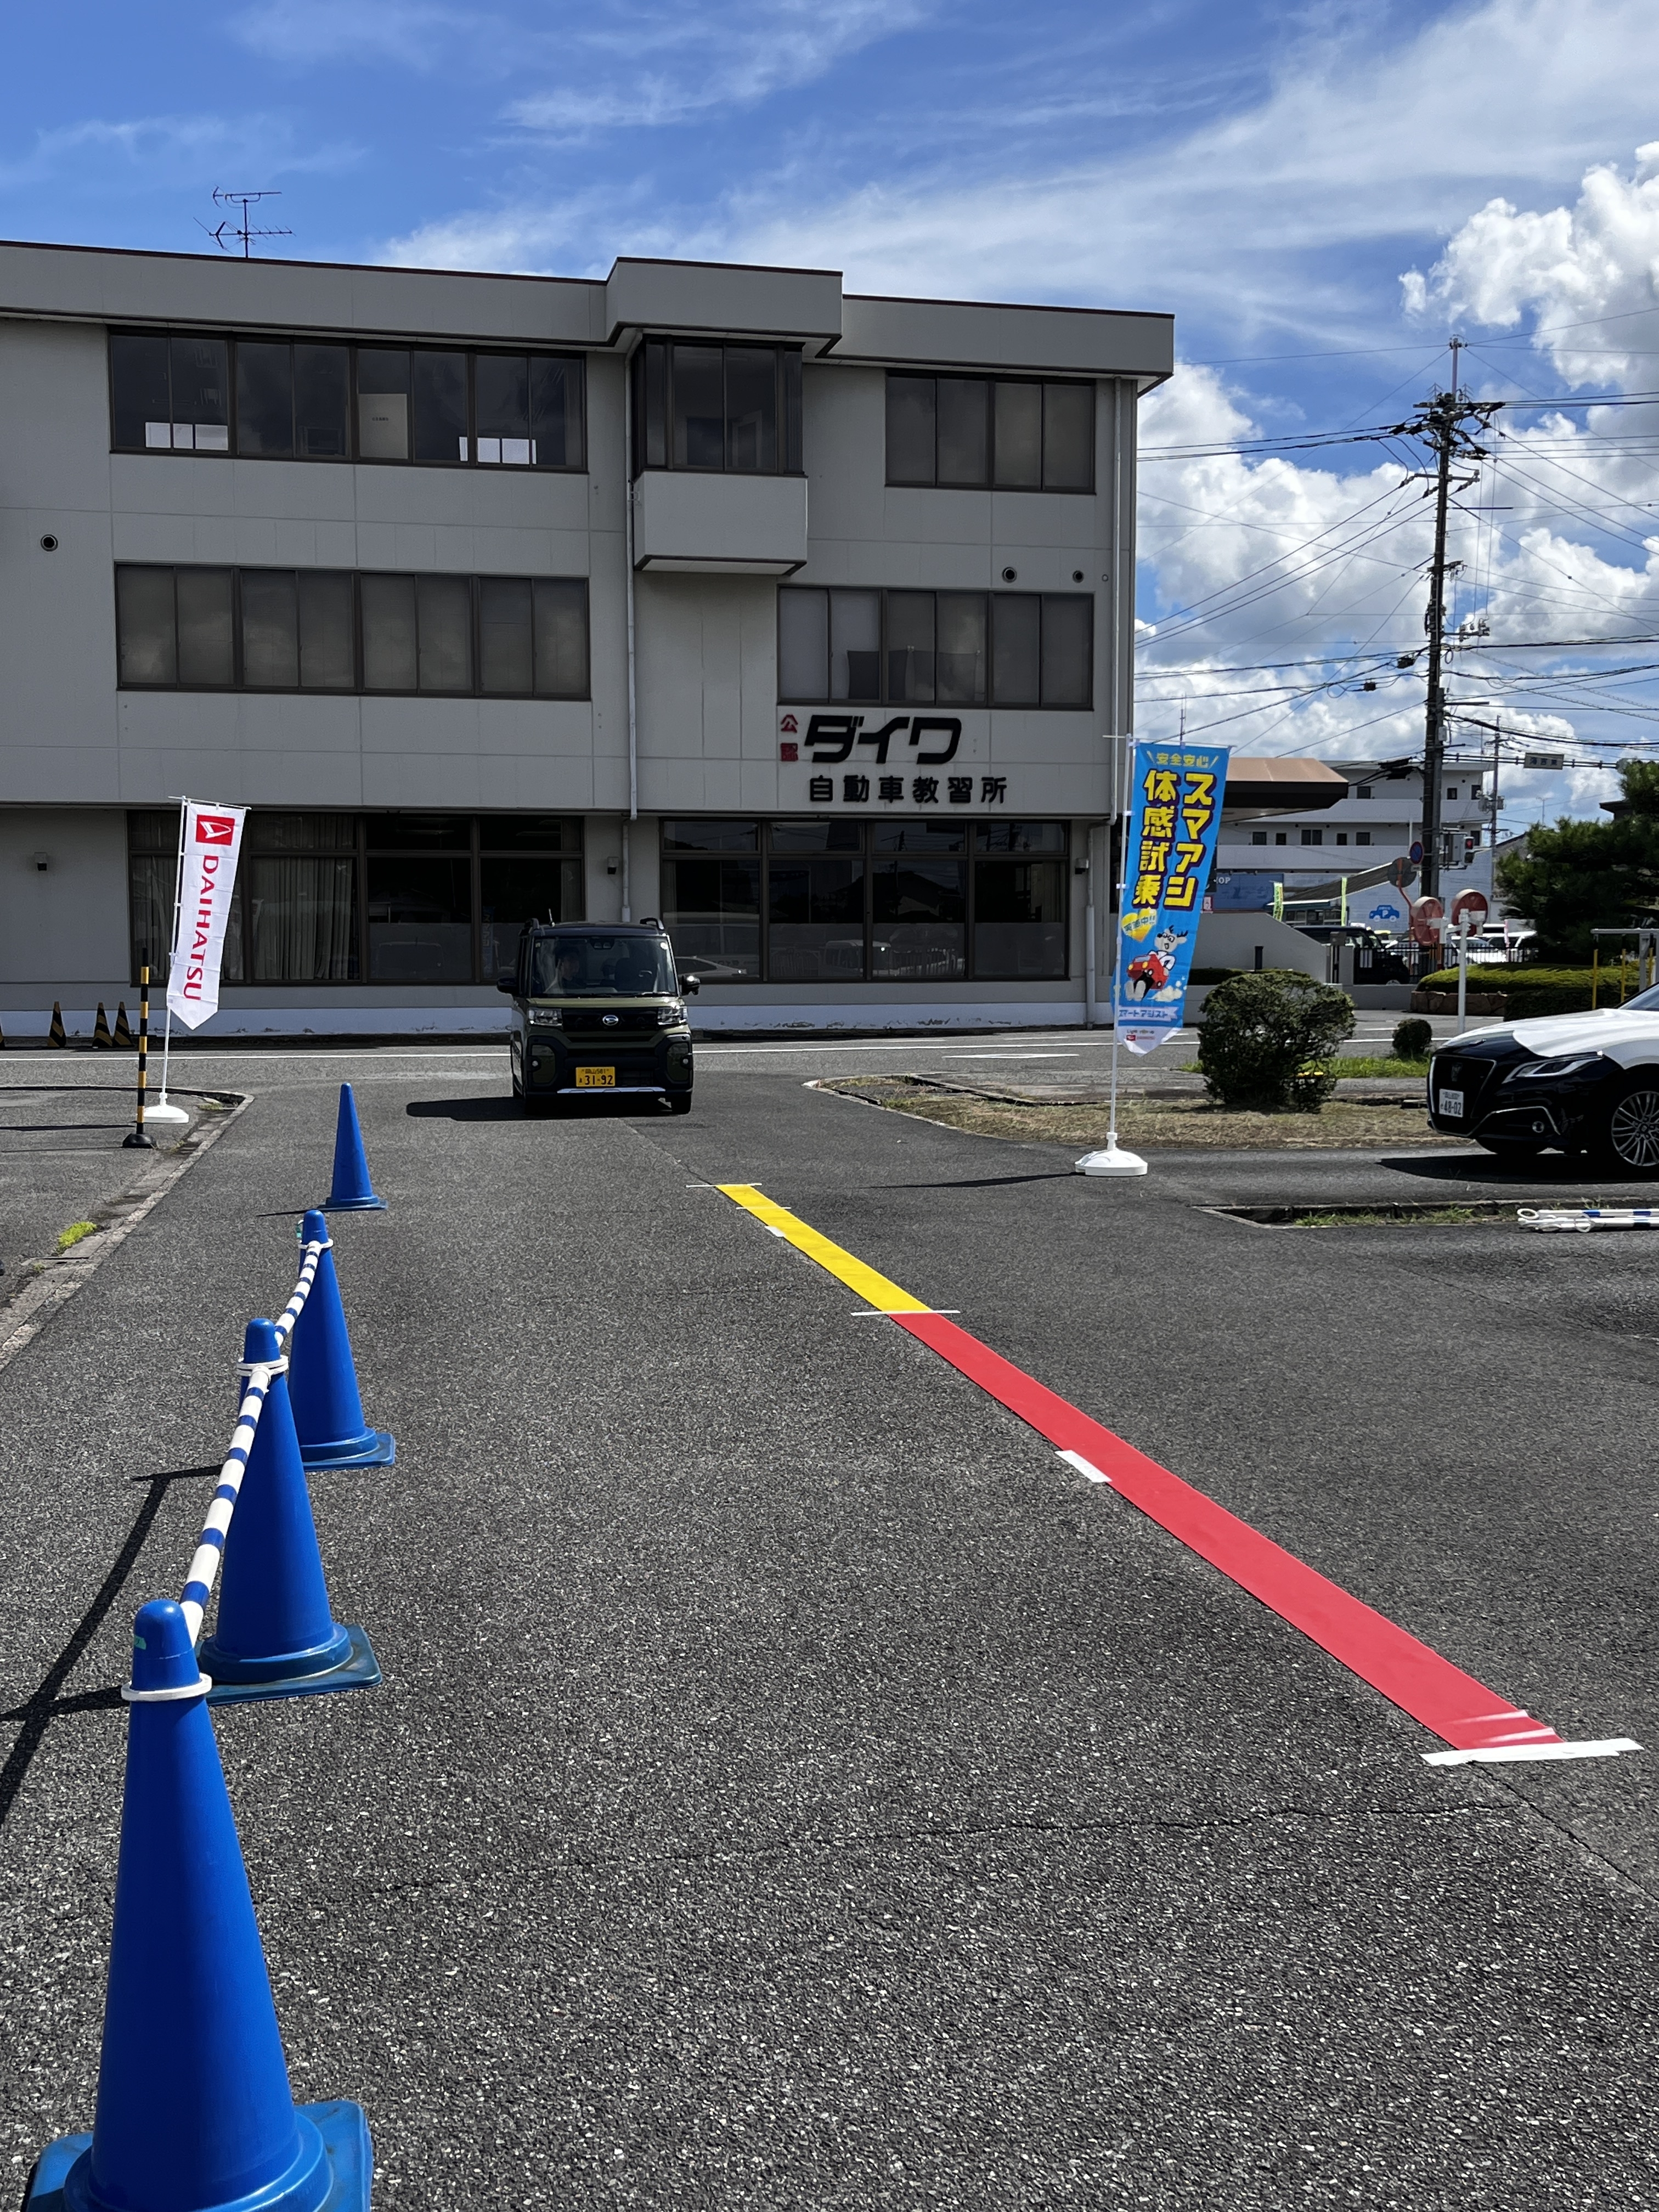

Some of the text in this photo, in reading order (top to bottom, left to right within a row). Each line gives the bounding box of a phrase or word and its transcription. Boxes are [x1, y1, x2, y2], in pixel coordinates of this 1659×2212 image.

[804, 714, 962, 765] ダイワ
[1155, 752, 1209, 769] 安全安心
[810, 775, 1007, 804] 自動車教習所
[1132, 769, 1178, 905] 体感試乗
[1163, 772, 1215, 907] スマアシ
[183, 855, 219, 1001] DAIHATSU
[584, 1075, 613, 1085] 31-92
